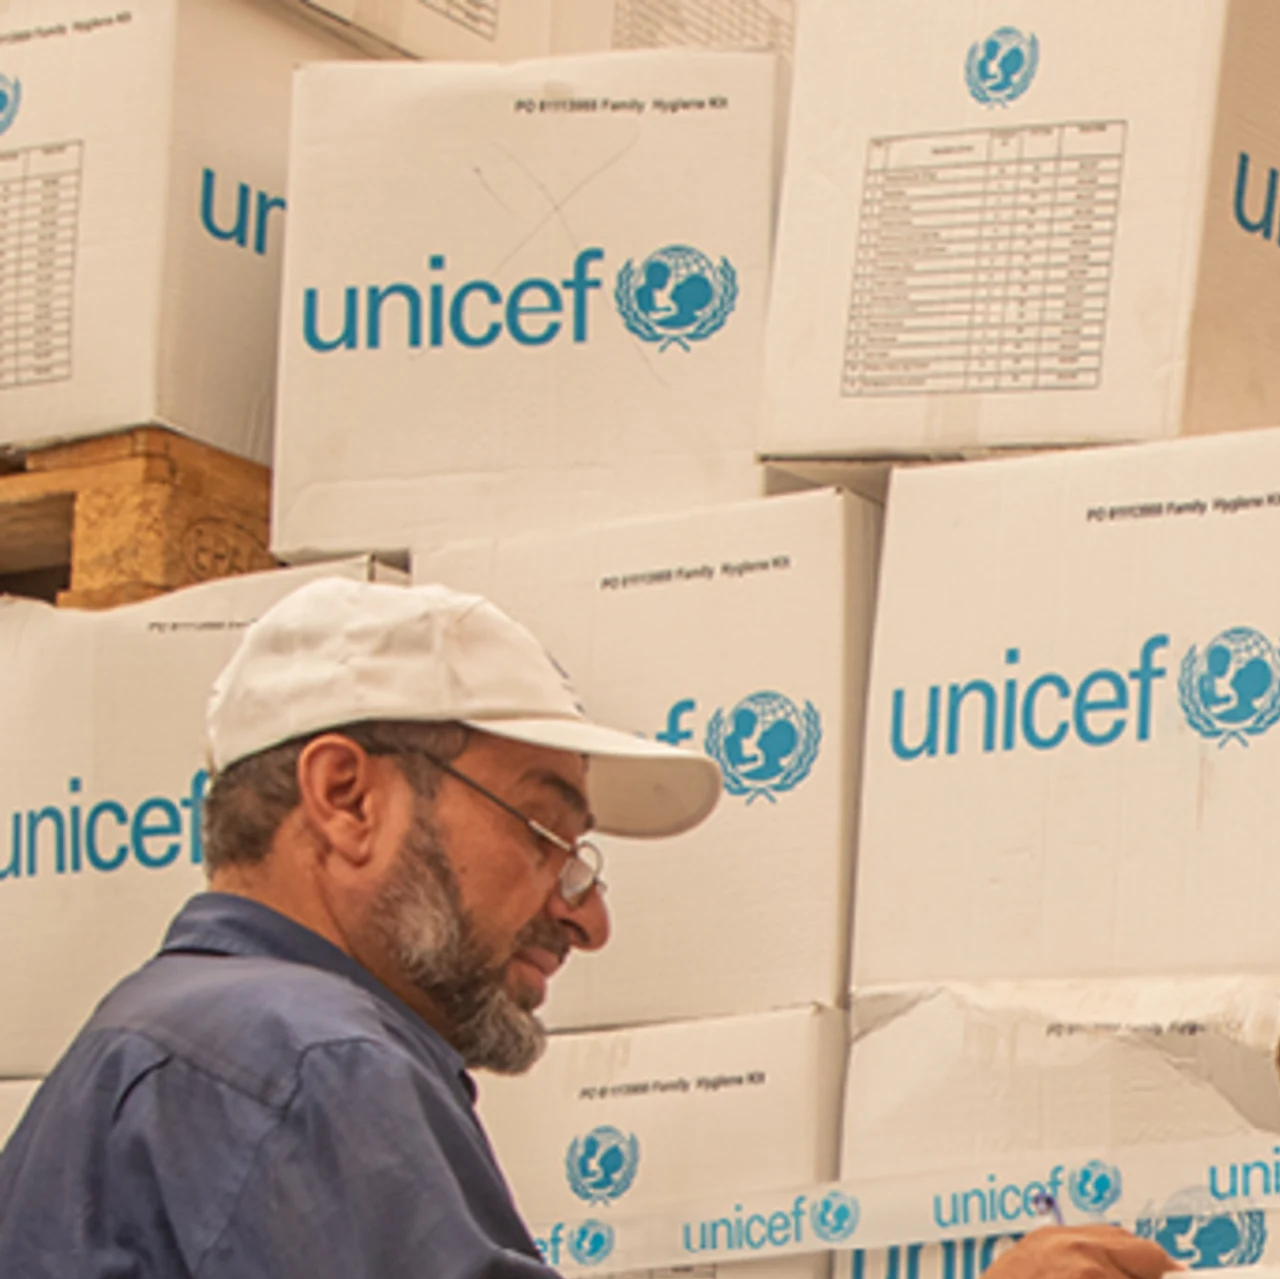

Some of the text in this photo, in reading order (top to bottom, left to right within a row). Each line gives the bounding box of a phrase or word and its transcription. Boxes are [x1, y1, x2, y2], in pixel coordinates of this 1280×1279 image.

[302, 247, 604, 353] unicef
[889, 634, 1171, 760] unicef
[682, 1195, 807, 1254] unicef
